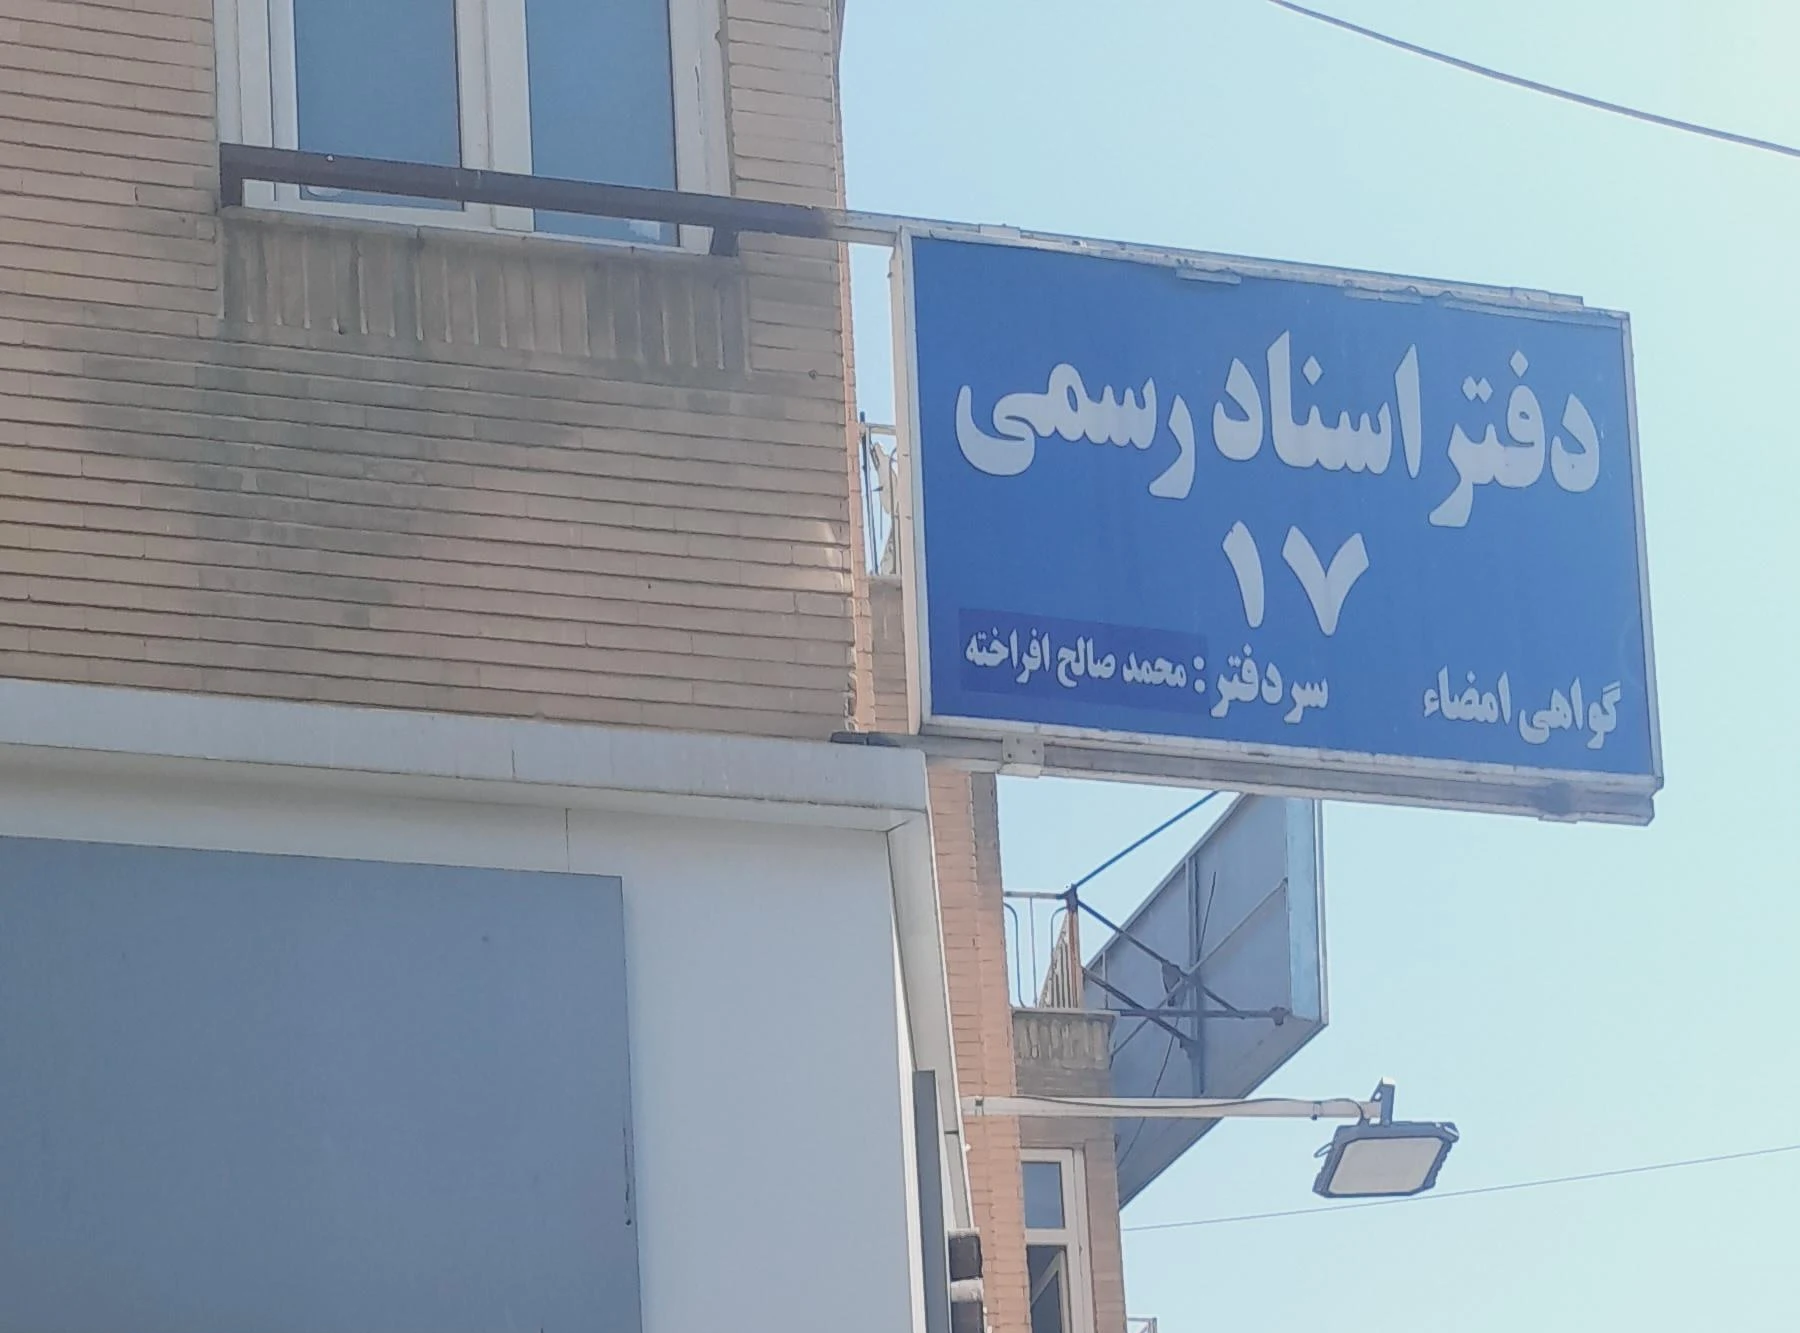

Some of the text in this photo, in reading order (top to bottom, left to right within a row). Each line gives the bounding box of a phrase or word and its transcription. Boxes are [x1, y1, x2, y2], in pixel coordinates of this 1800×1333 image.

[956, 330, 1601, 528] دفتر اسناد رسمی
[1222, 519, 1370, 637] ۱۷
[964, 626, 1051, 684] افراخته
[1056, 635, 1117, 688] صالح
[1121, 650, 1188, 688] محمد
[1422, 663, 1623, 750] گواهی امضاء
